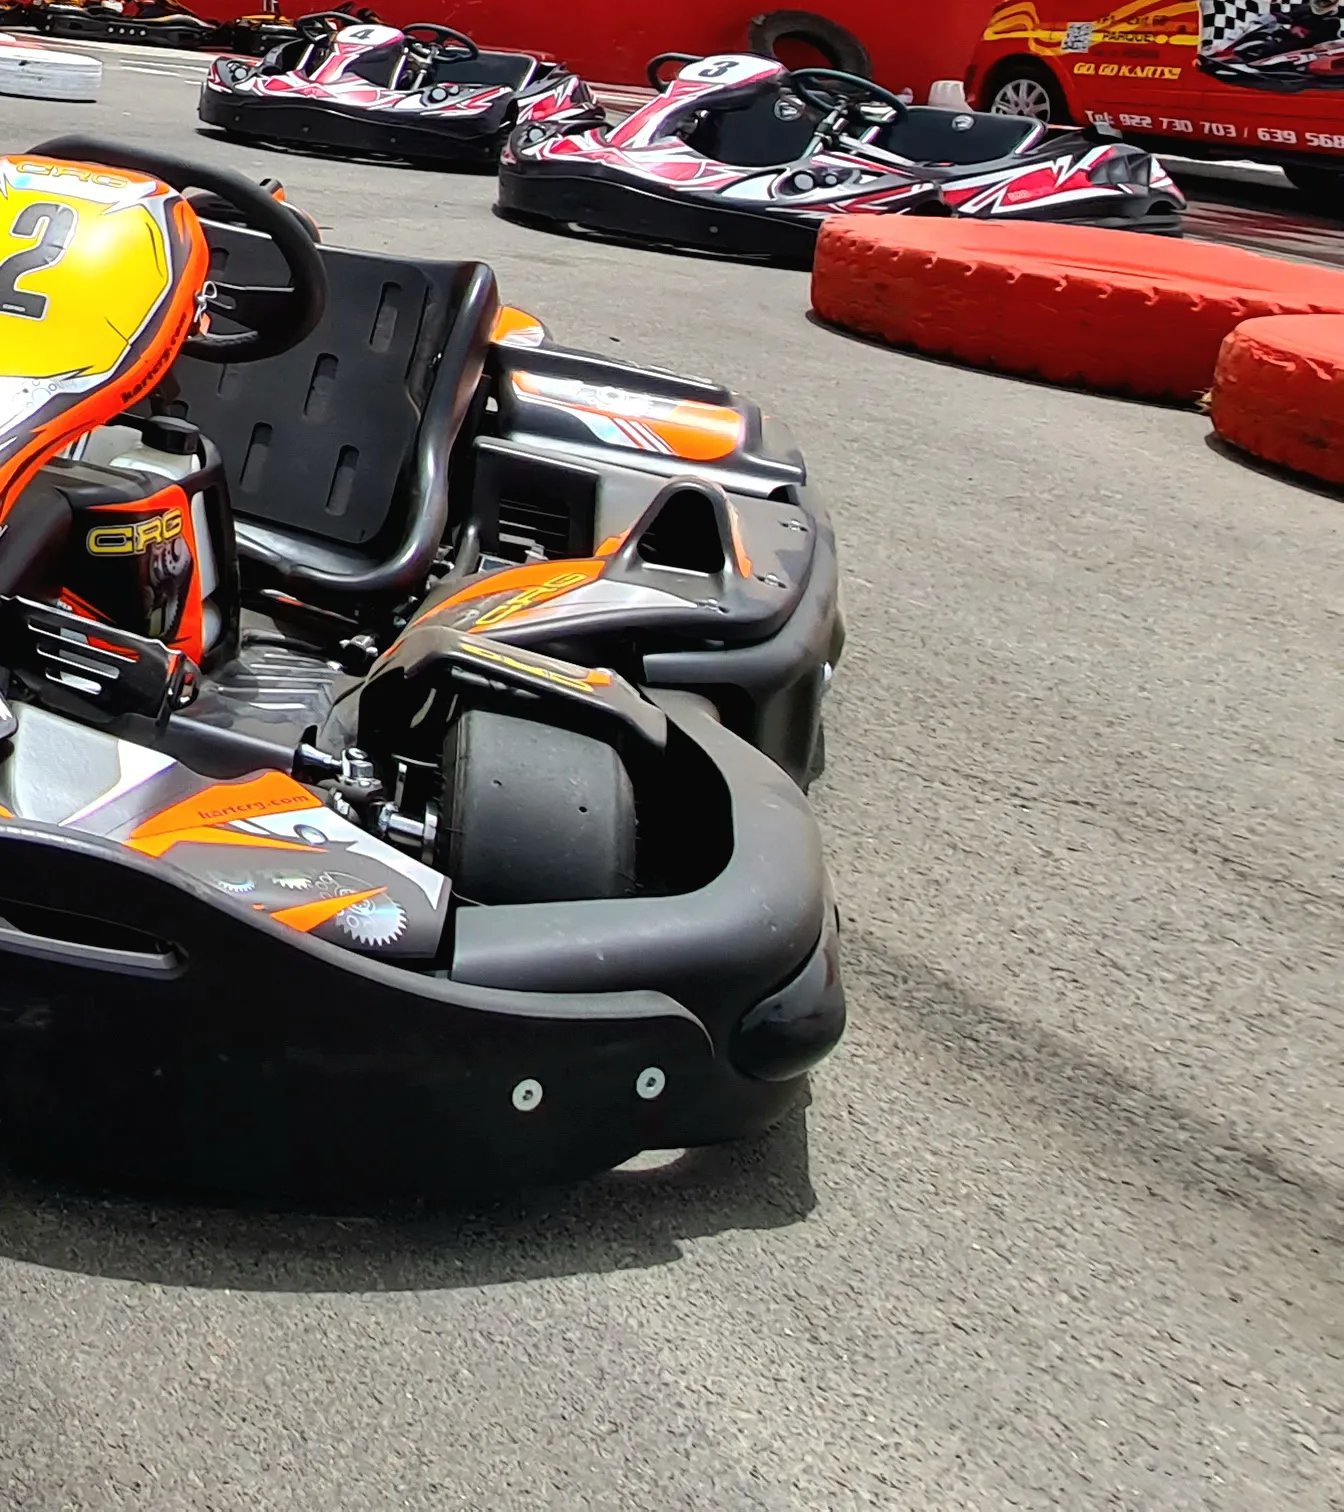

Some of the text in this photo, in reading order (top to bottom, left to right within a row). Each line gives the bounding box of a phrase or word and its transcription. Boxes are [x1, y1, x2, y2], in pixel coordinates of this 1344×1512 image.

[348, 27, 373, 42] 4
[697, 60, 740, 78] 3
[1119, 113, 1153, 129] 922
[1159, 117, 1194, 133] 730
[1200, 121, 1238, 138] 703
[1256, 127, 1298, 144] 639
[1304, 132, 1344, 149] 568
[15, 160, 129, 189] CRG
[87, 506, 183, 557] CRG
